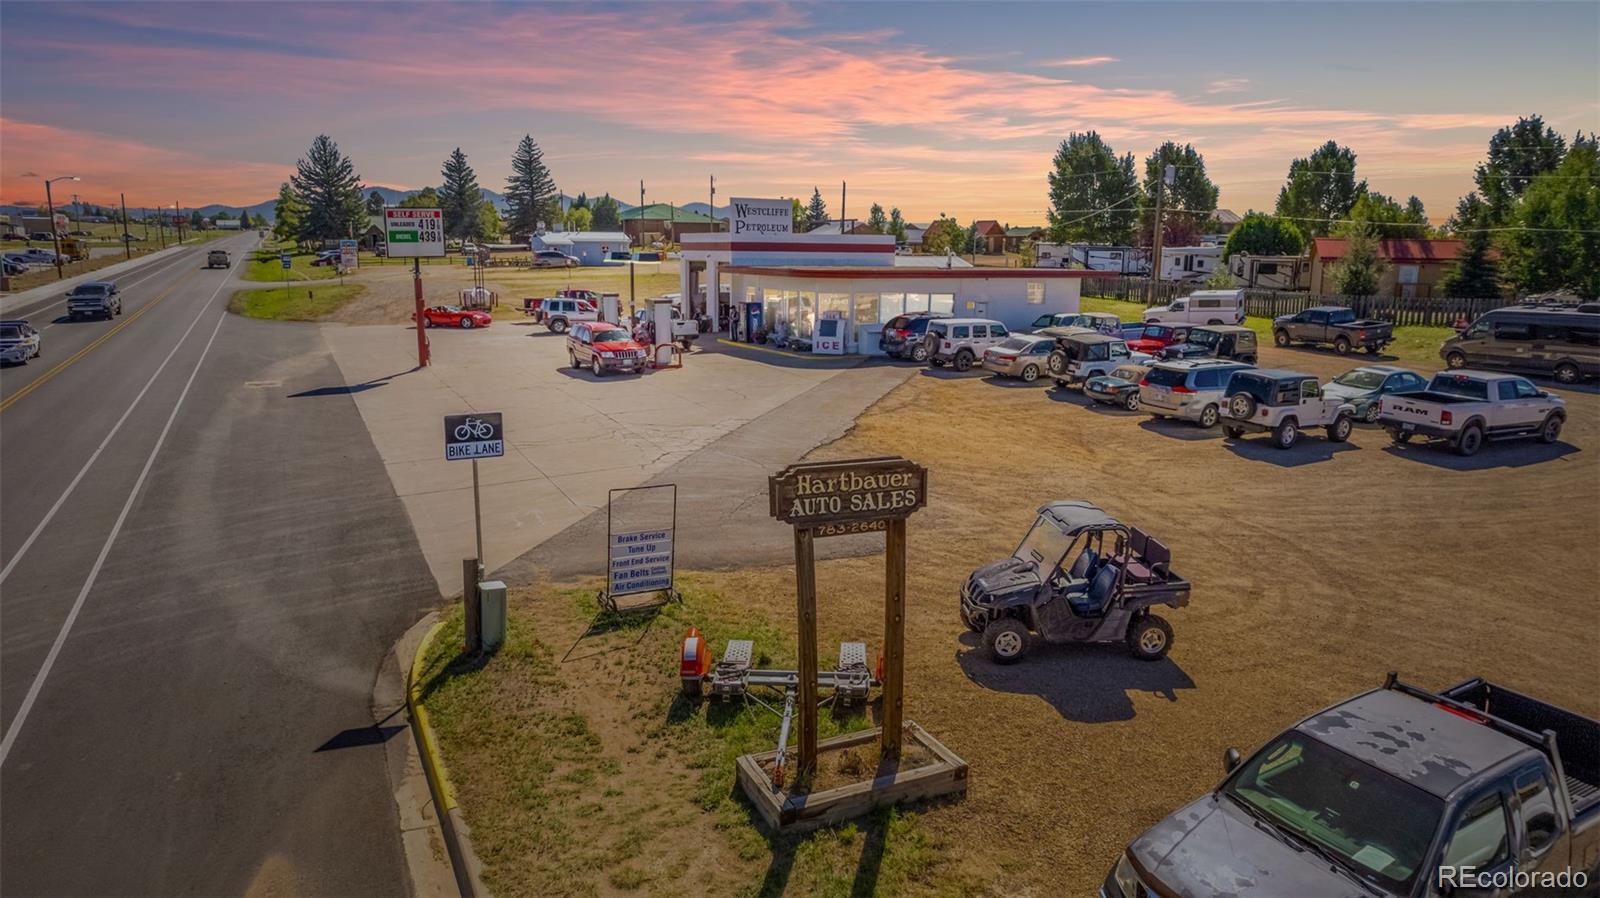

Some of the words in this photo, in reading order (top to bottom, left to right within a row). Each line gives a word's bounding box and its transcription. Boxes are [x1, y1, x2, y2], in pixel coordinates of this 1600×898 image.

[816, 341, 840, 350] ICE
[1393, 404, 1428, 416] RAM
[449, 445, 471, 457] BIKE
[474, 442, 501, 455] LANE
[796, 472, 913, 495] Hartbauer
[789, 496, 841, 517] AUTO
[850, 490, 916, 511] SALES
[818, 520, 887, 536] 783-2640
[617, 535, 638, 543] Brake
[640, 532, 666, 541] Service
[646, 544, 656, 552] Up
[612, 560, 630, 568] Front
[631, 558, 644, 566] End
[645, 555, 670, 564] Service
[614, 571, 628, 580] Fan
[630, 569, 649, 578] Belts
[614, 583, 625, 591] Air
[626, 578, 670, 590] Conditioning
